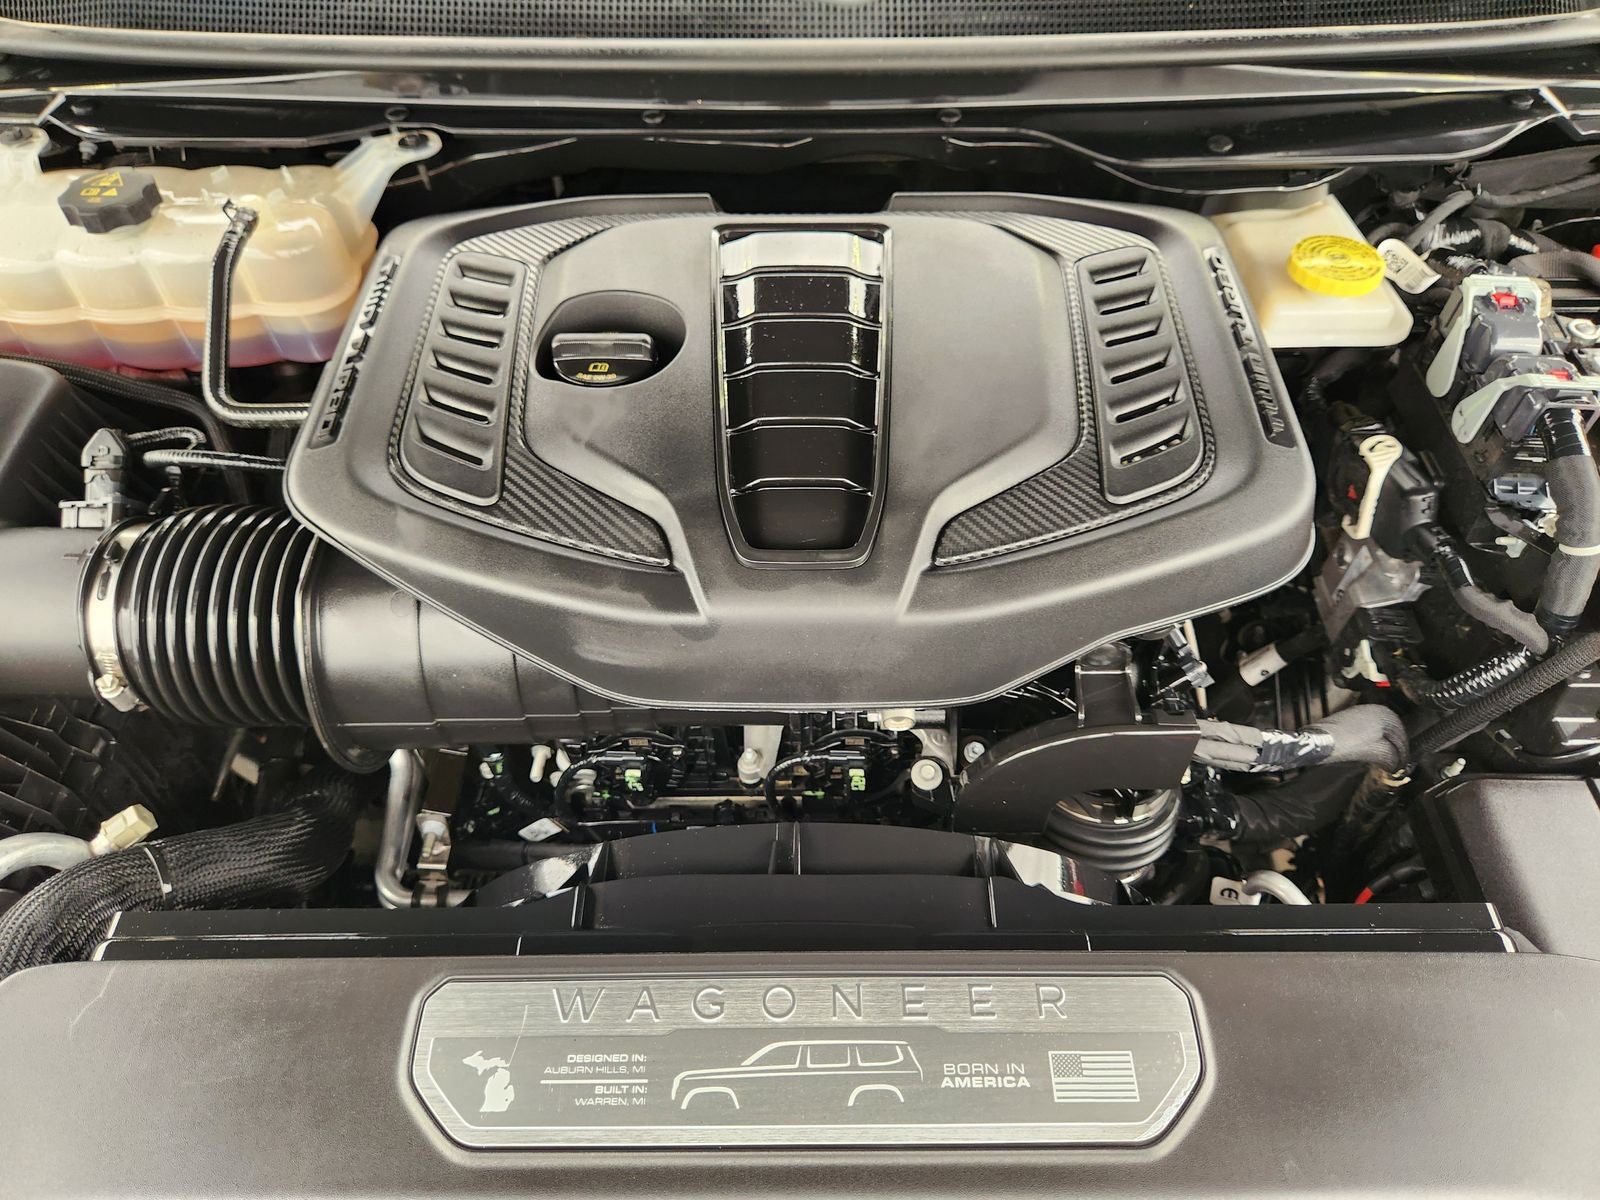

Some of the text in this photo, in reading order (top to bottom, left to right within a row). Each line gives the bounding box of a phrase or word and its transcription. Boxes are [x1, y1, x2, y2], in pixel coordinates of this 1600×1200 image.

[552, 983, 1068, 1023] WAGONEER
[567, 1053, 647, 1063] DESIGNED IN:
[543, 1065, 646, 1075] AUBURN HILLS, MI
[943, 1063, 1025, 1075] BORN IN
[940, 1075, 1031, 1089] AMERICA
[594, 1085, 648, 1094] BUILT IN:
[574, 1096, 646, 1106] WARREN, MI
